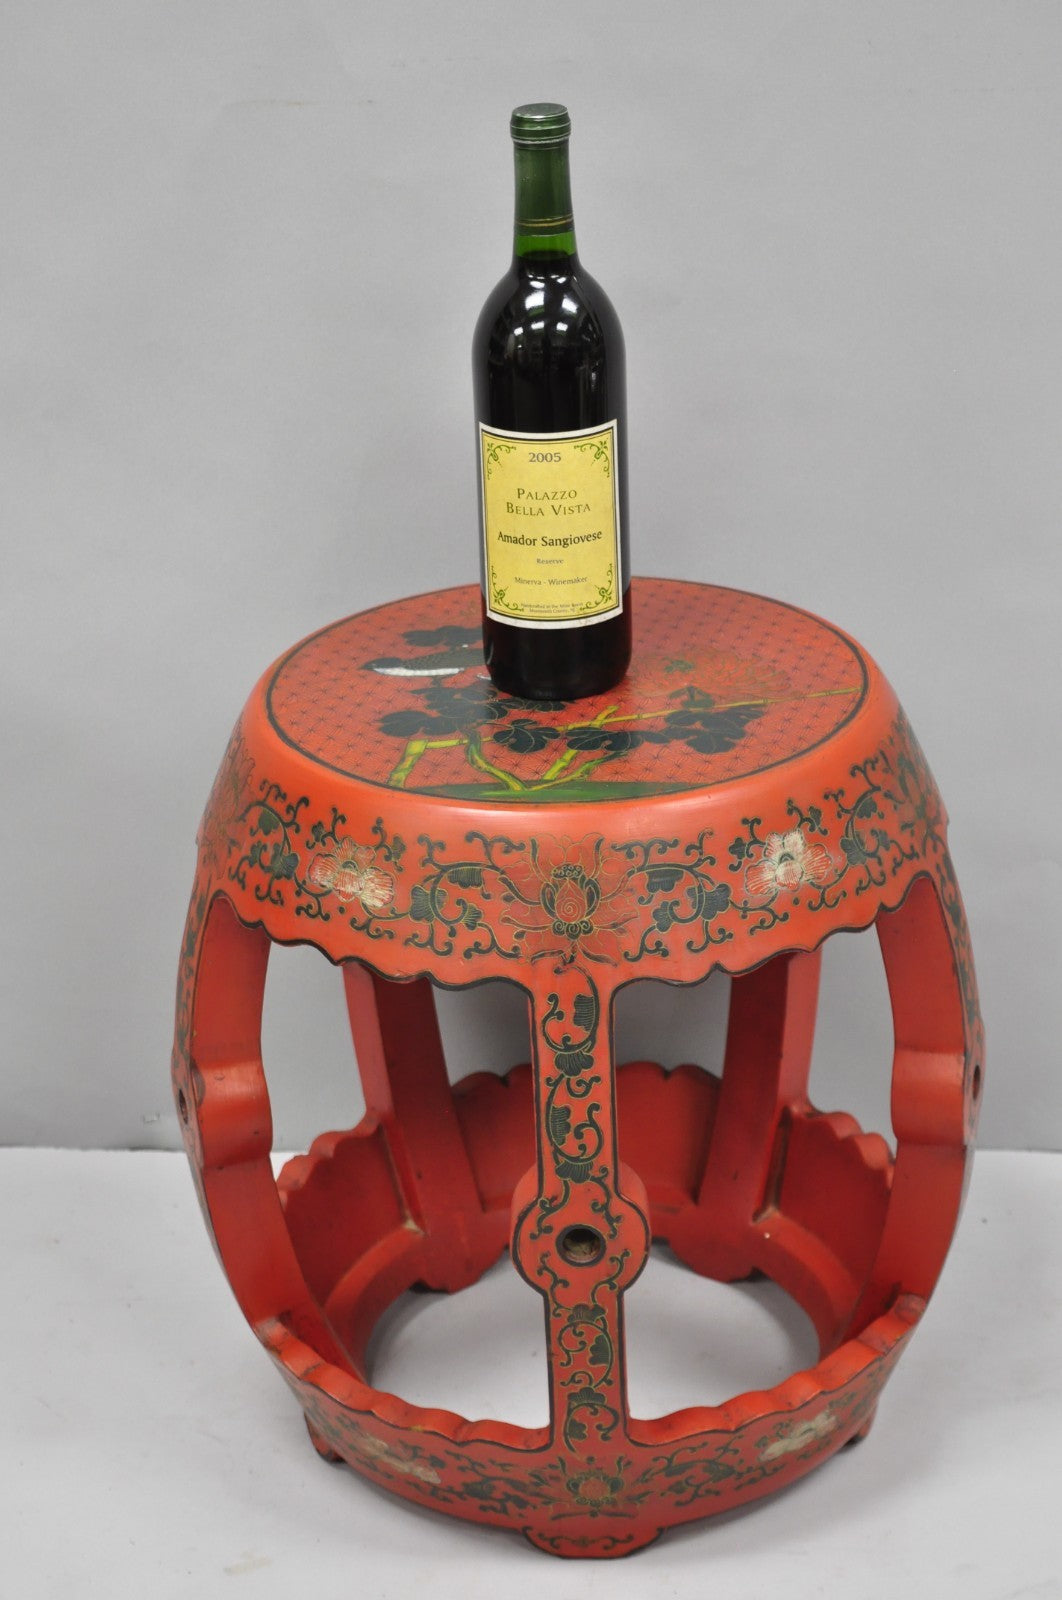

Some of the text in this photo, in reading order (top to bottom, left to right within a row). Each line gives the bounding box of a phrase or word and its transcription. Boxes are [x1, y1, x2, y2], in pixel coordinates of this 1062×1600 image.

[528, 452, 562, 463] 2005
[517, 488, 578, 501] PALAZZO
[506, 502, 591, 517] BELLA VISTA
[497, 530, 603, 549] Amador Sangiovese
[536, 557, 565, 565] Reserve
[514, 576, 542, 586] Minerva
[548, 576, 589, 586] Winemaker
